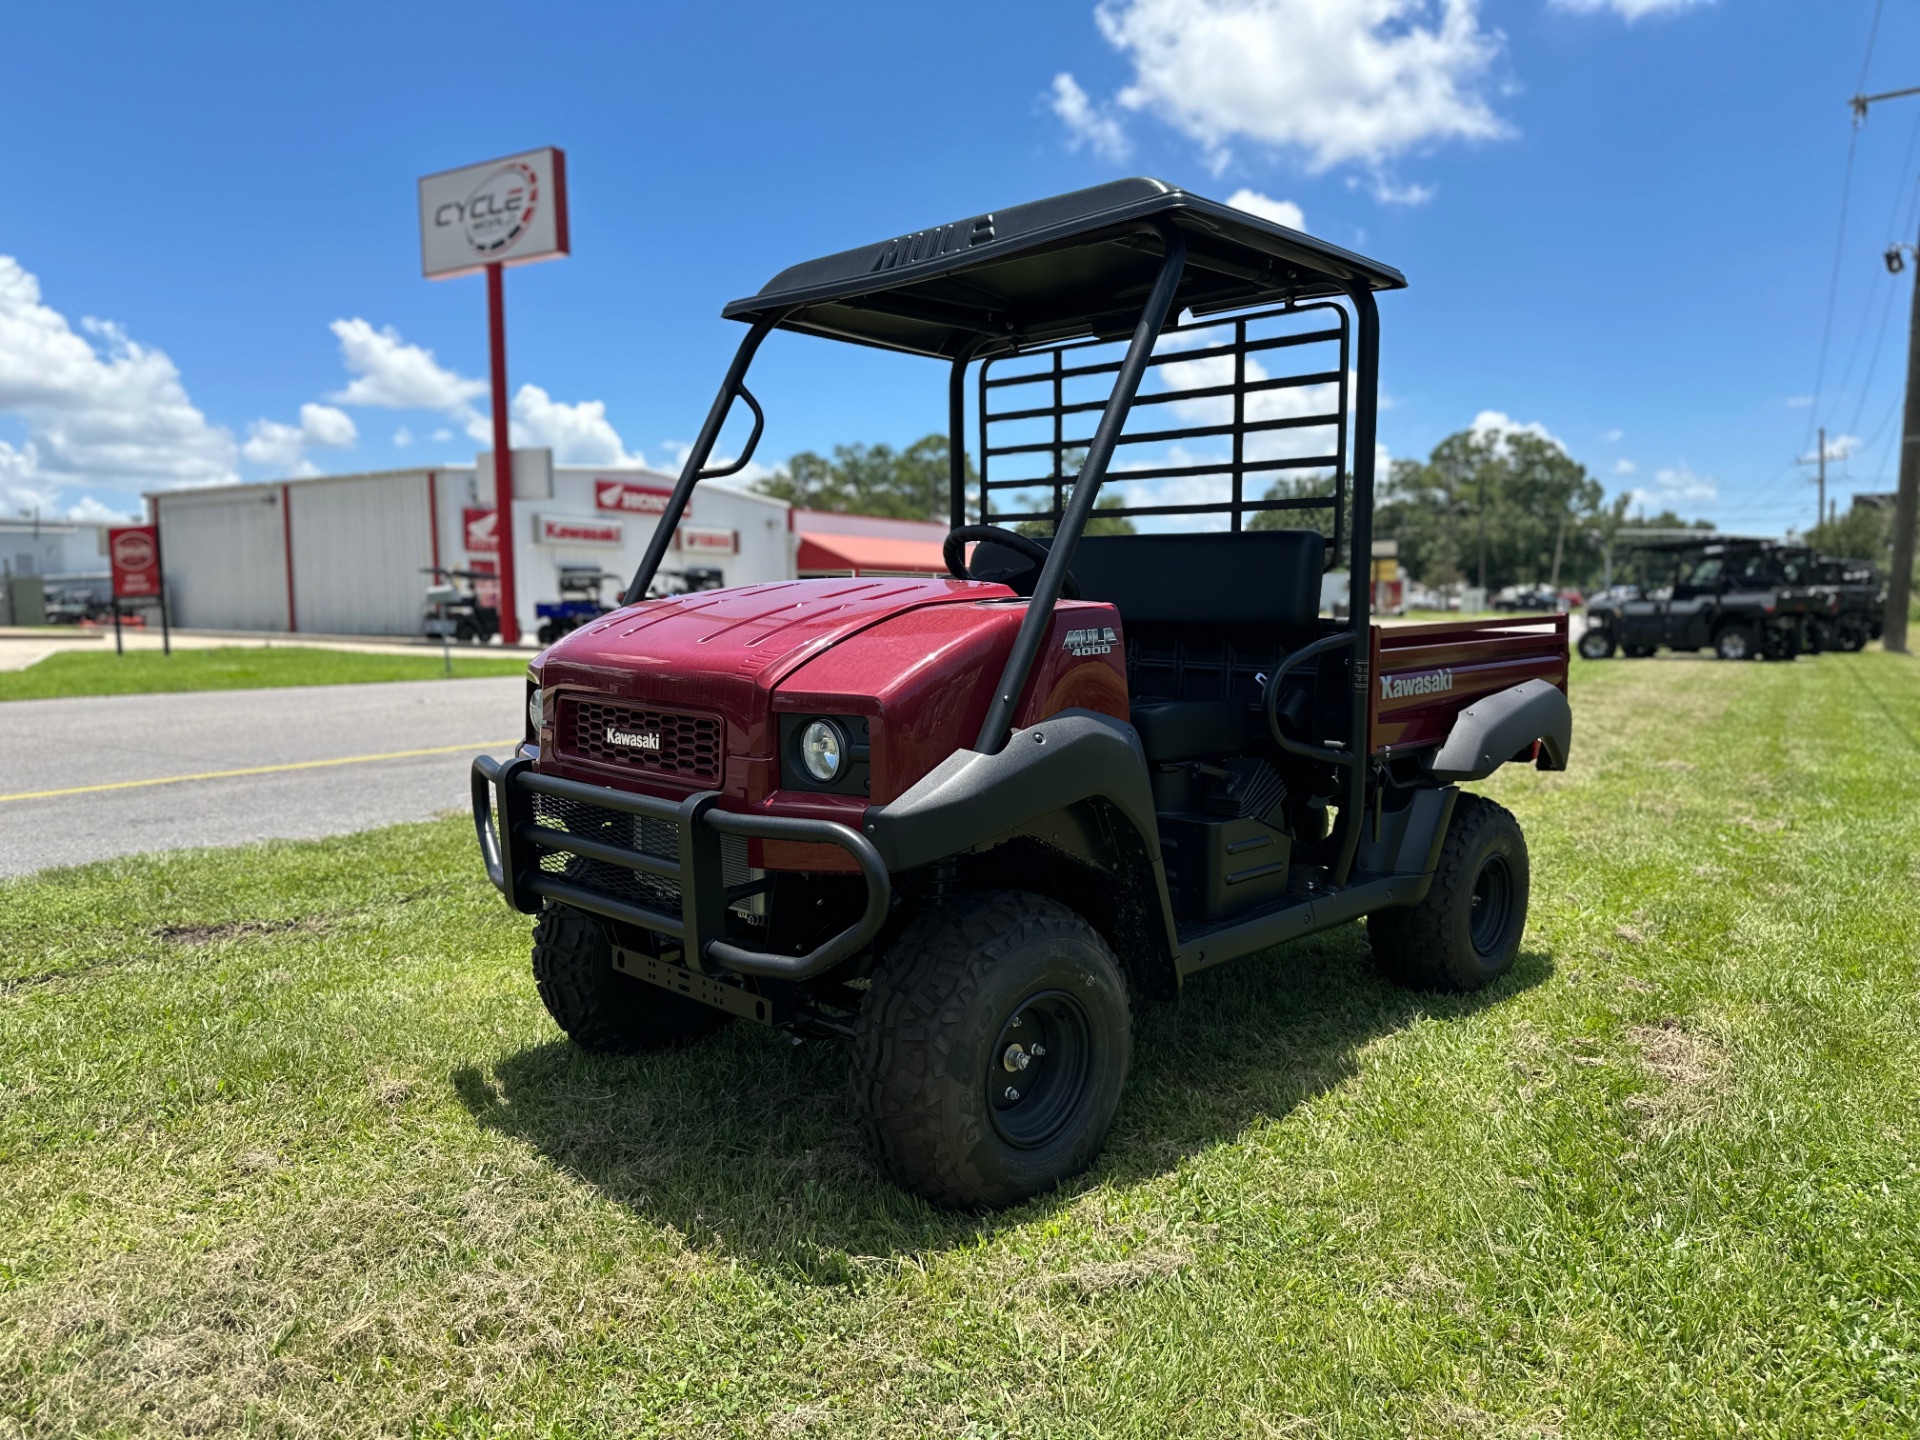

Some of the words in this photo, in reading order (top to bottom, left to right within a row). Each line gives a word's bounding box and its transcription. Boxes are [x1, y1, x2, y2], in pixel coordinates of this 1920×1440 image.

[435, 187, 523, 227] CYCLE
[867, 214, 995, 273] MULE
[545, 521, 621, 542] Kawasaki
[1062, 627, 1119, 650] MULE
[1072, 646, 1111, 656] 4000
[1380, 668, 1453, 700] Kawasaki
[606, 728, 660, 750] Kawasaki
